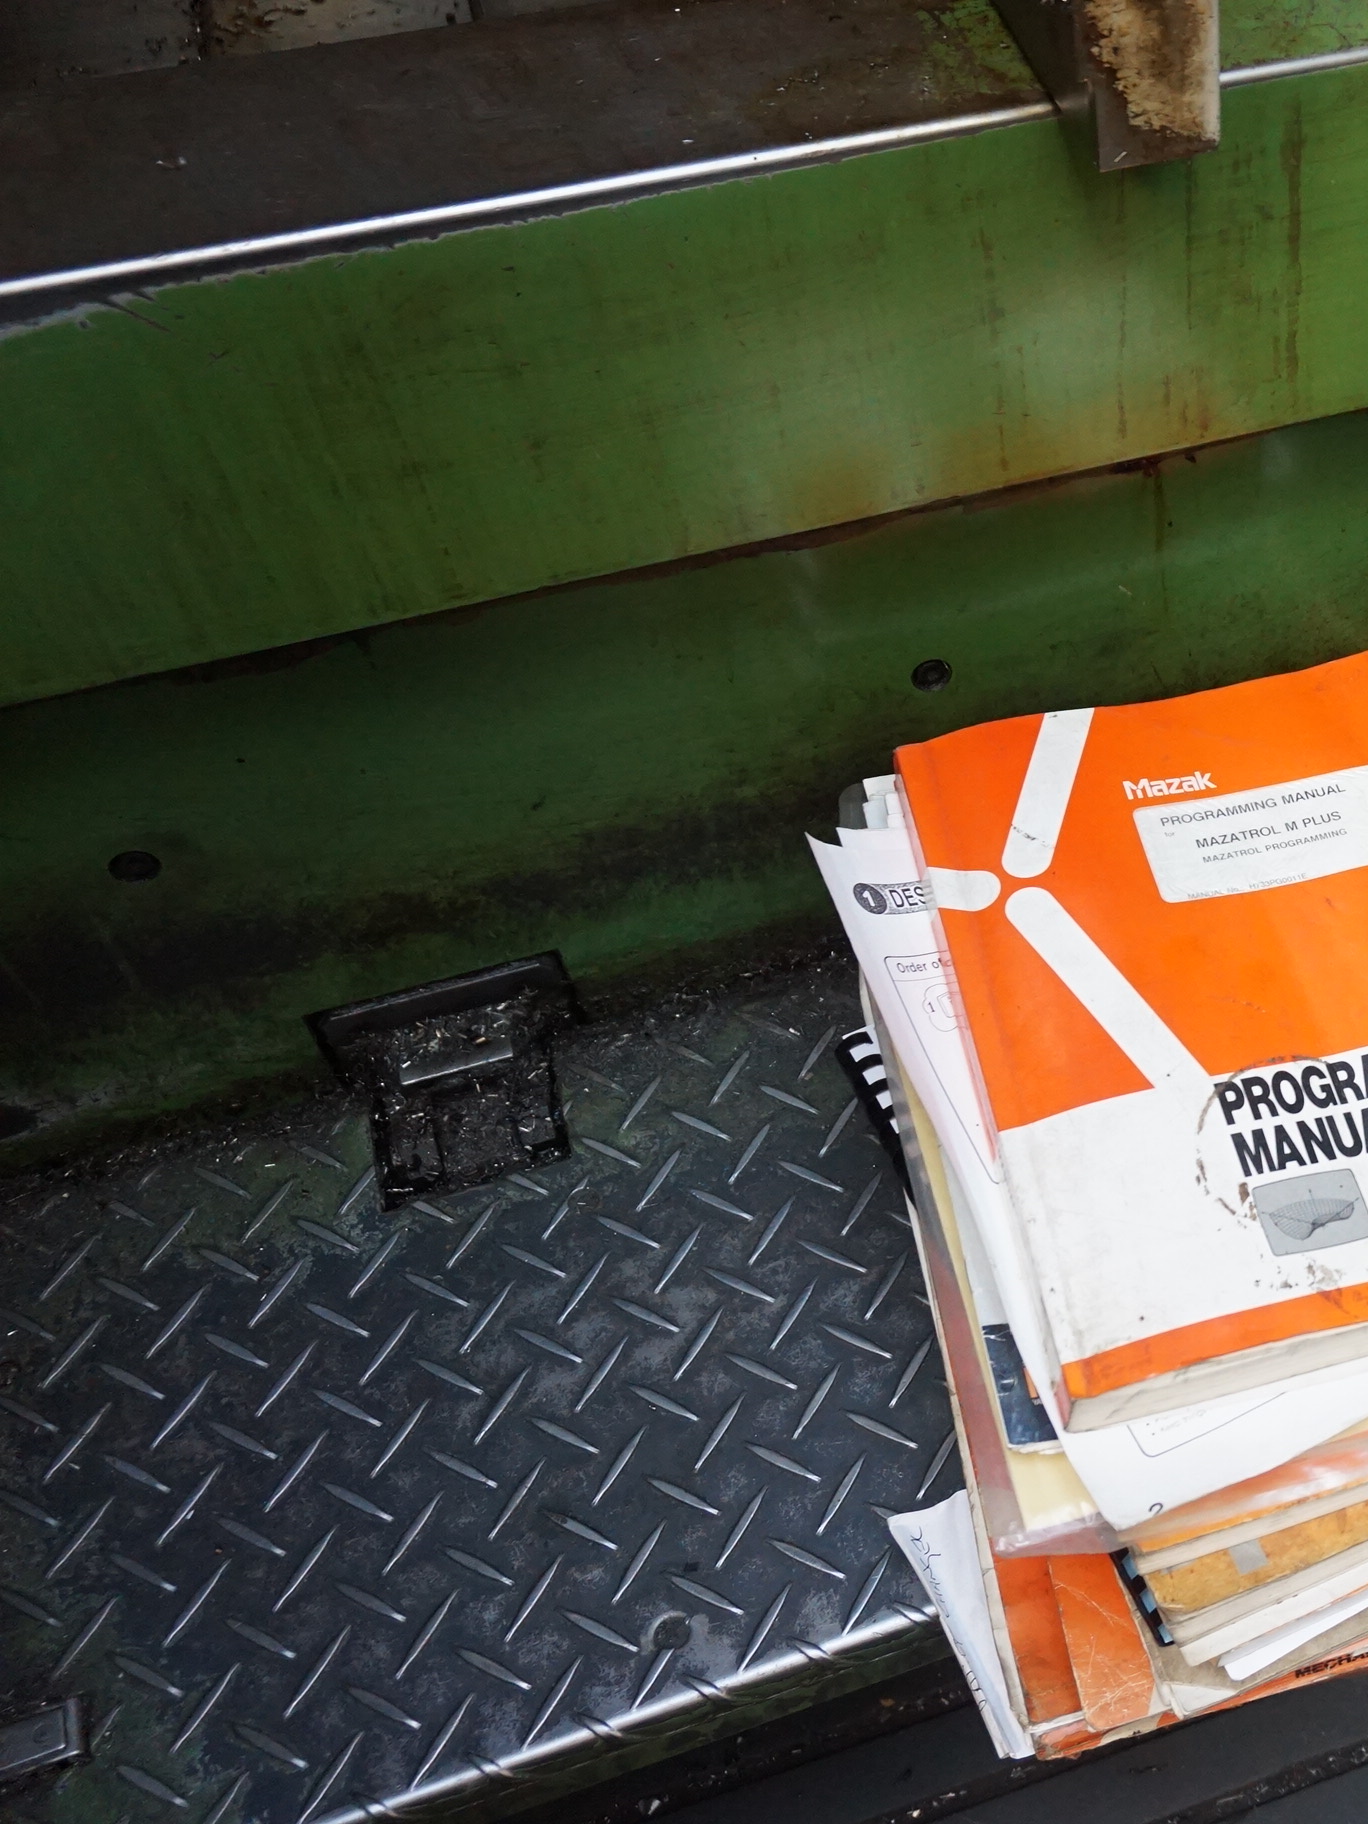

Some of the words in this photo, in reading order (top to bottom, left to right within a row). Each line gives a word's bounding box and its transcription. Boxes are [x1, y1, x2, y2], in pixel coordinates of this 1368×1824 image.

[1122, 771, 1218, 800] Mazak
[1160, 797, 1278, 827] PROGRAMMING
[1281, 782, 1347, 805] MANUAL
[1195, 824, 1281, 849] MAZATROL
[1284, 820, 1299, 833] M
[1302, 810, 1342, 829] PLUS
[1202, 846, 1263, 864] MAZATROL
[1264, 827, 1348, 852] PROGRAMMING
[896, 961, 928, 973] Order
